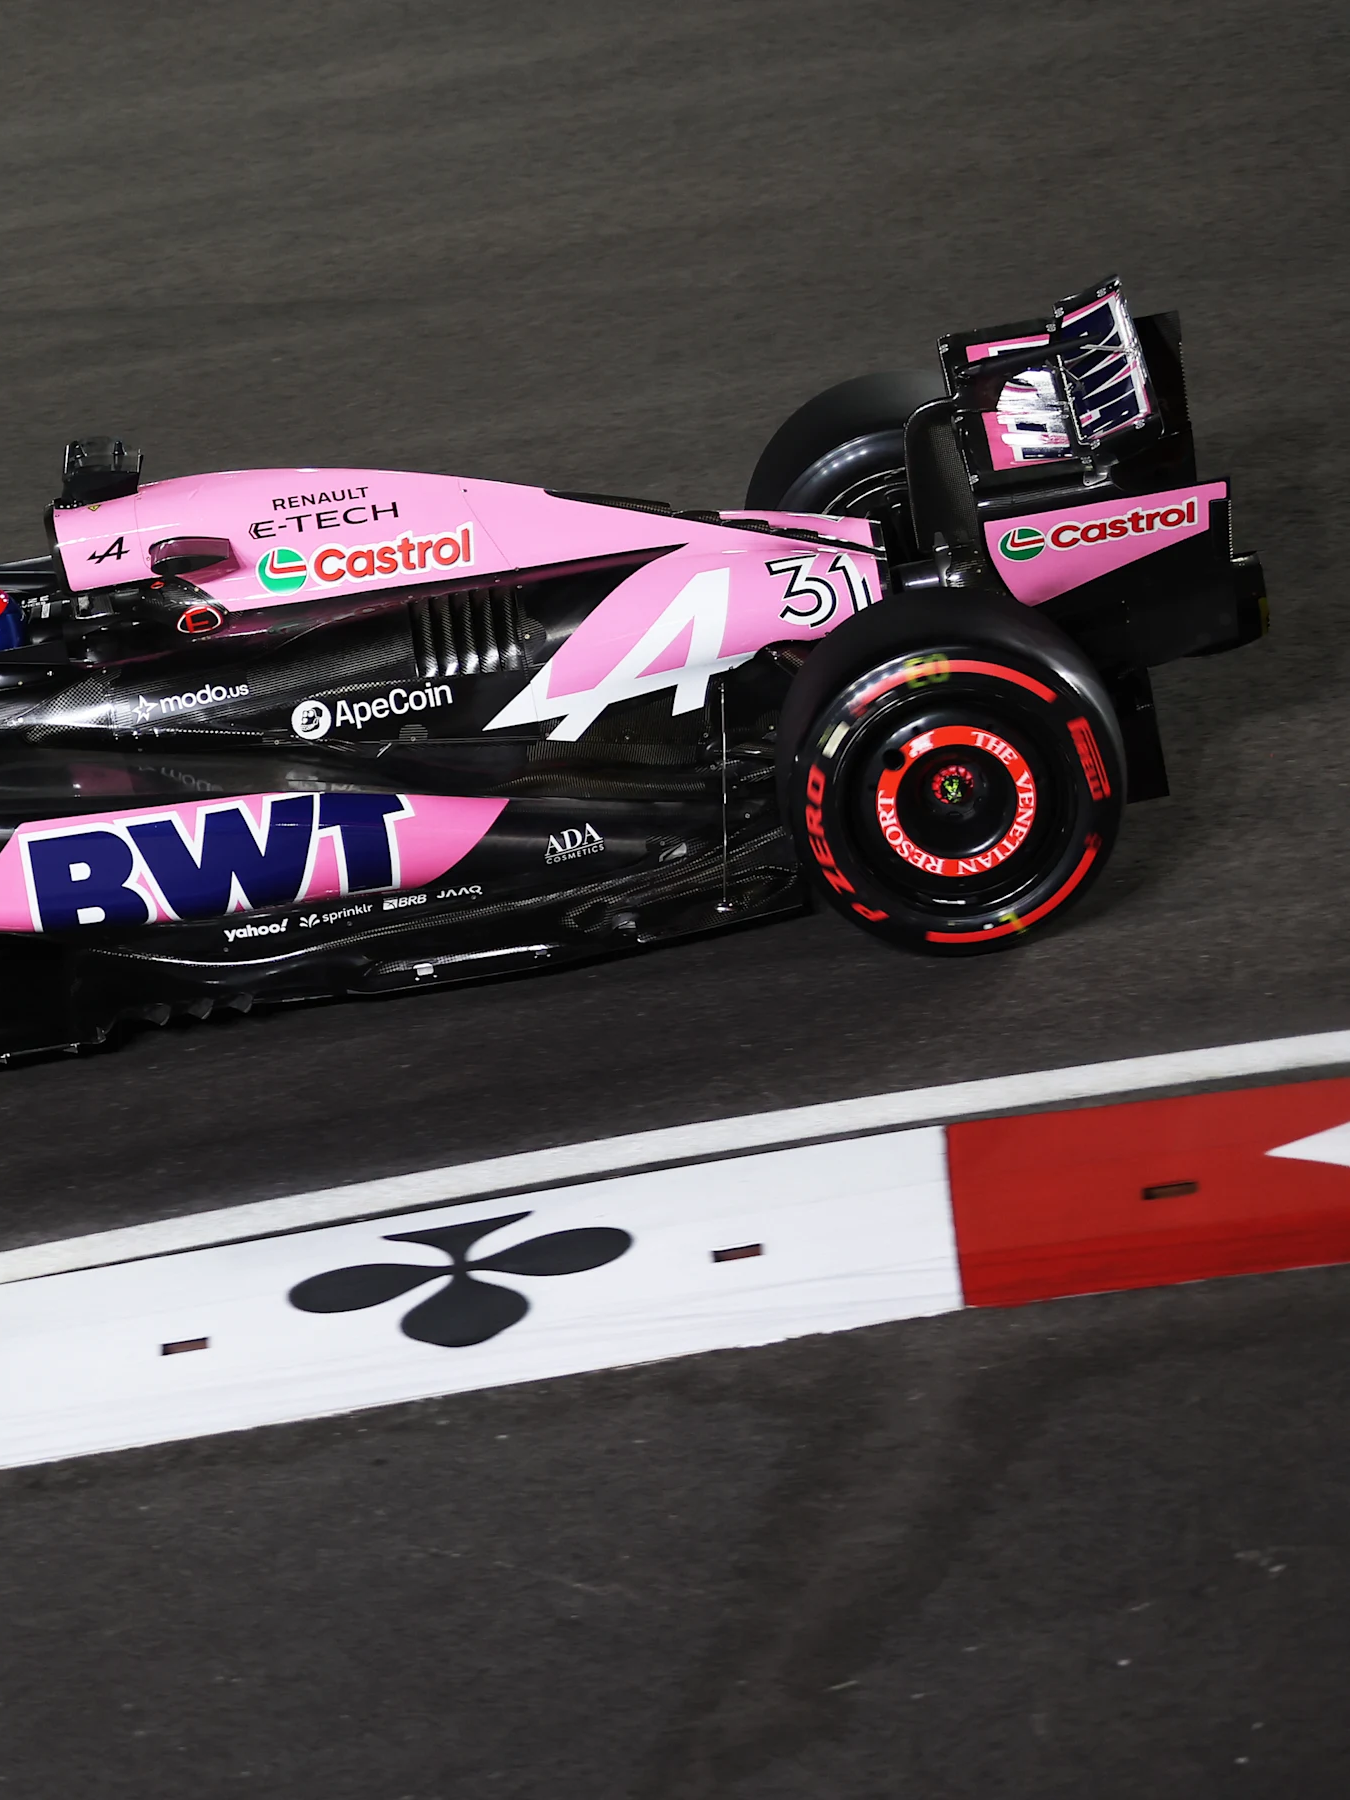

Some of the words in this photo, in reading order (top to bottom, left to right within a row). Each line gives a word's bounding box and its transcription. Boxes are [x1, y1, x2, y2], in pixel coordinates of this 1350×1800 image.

[272, 486, 369, 512] RENAULT
[248, 501, 400, 541] E-TECH
[1051, 501, 1195, 549] Castrol
[313, 527, 472, 583] Castrol
[764, 553, 875, 629] 31
[159, 682, 250, 714] modo.us
[335, 680, 454, 729] ApeCoin
[971, 730, 1019, 765] THE
[545, 823, 603, 855] ADA
[805, 764, 857, 895] ZERO
[876, 790, 944, 875] RESORT
[956, 769, 1035, 876] VENETIAN
[17, 791, 416, 932] BWT
[546, 844, 605, 865] COSMETICS
[322, 902, 373, 925] sprinklr
[398, 894, 427, 908] BRB
[851, 902, 890, 922] P
[223, 918, 289, 942] yahoo!
